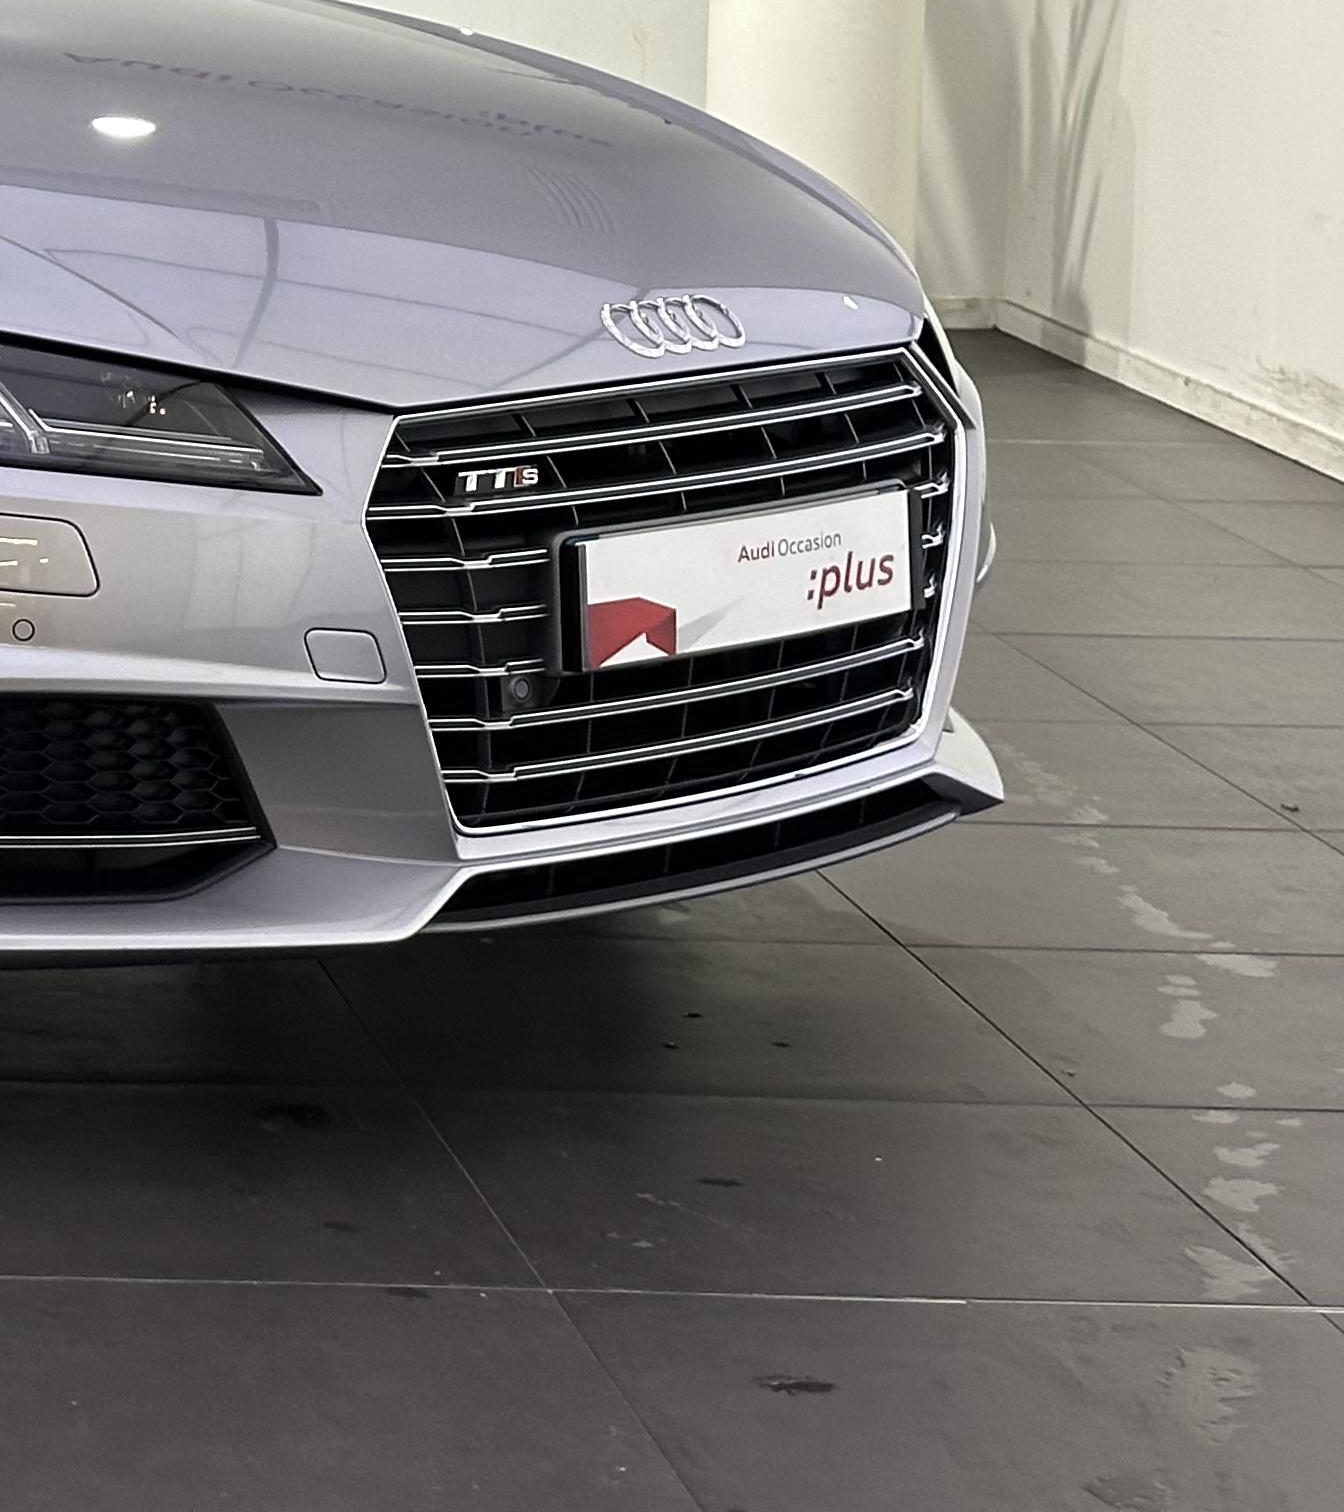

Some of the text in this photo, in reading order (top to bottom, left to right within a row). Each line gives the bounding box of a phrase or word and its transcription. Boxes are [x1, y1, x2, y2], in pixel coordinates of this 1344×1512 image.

[737, 531, 842, 563] Audi Occasion
[807, 551, 895, 610] :plus
